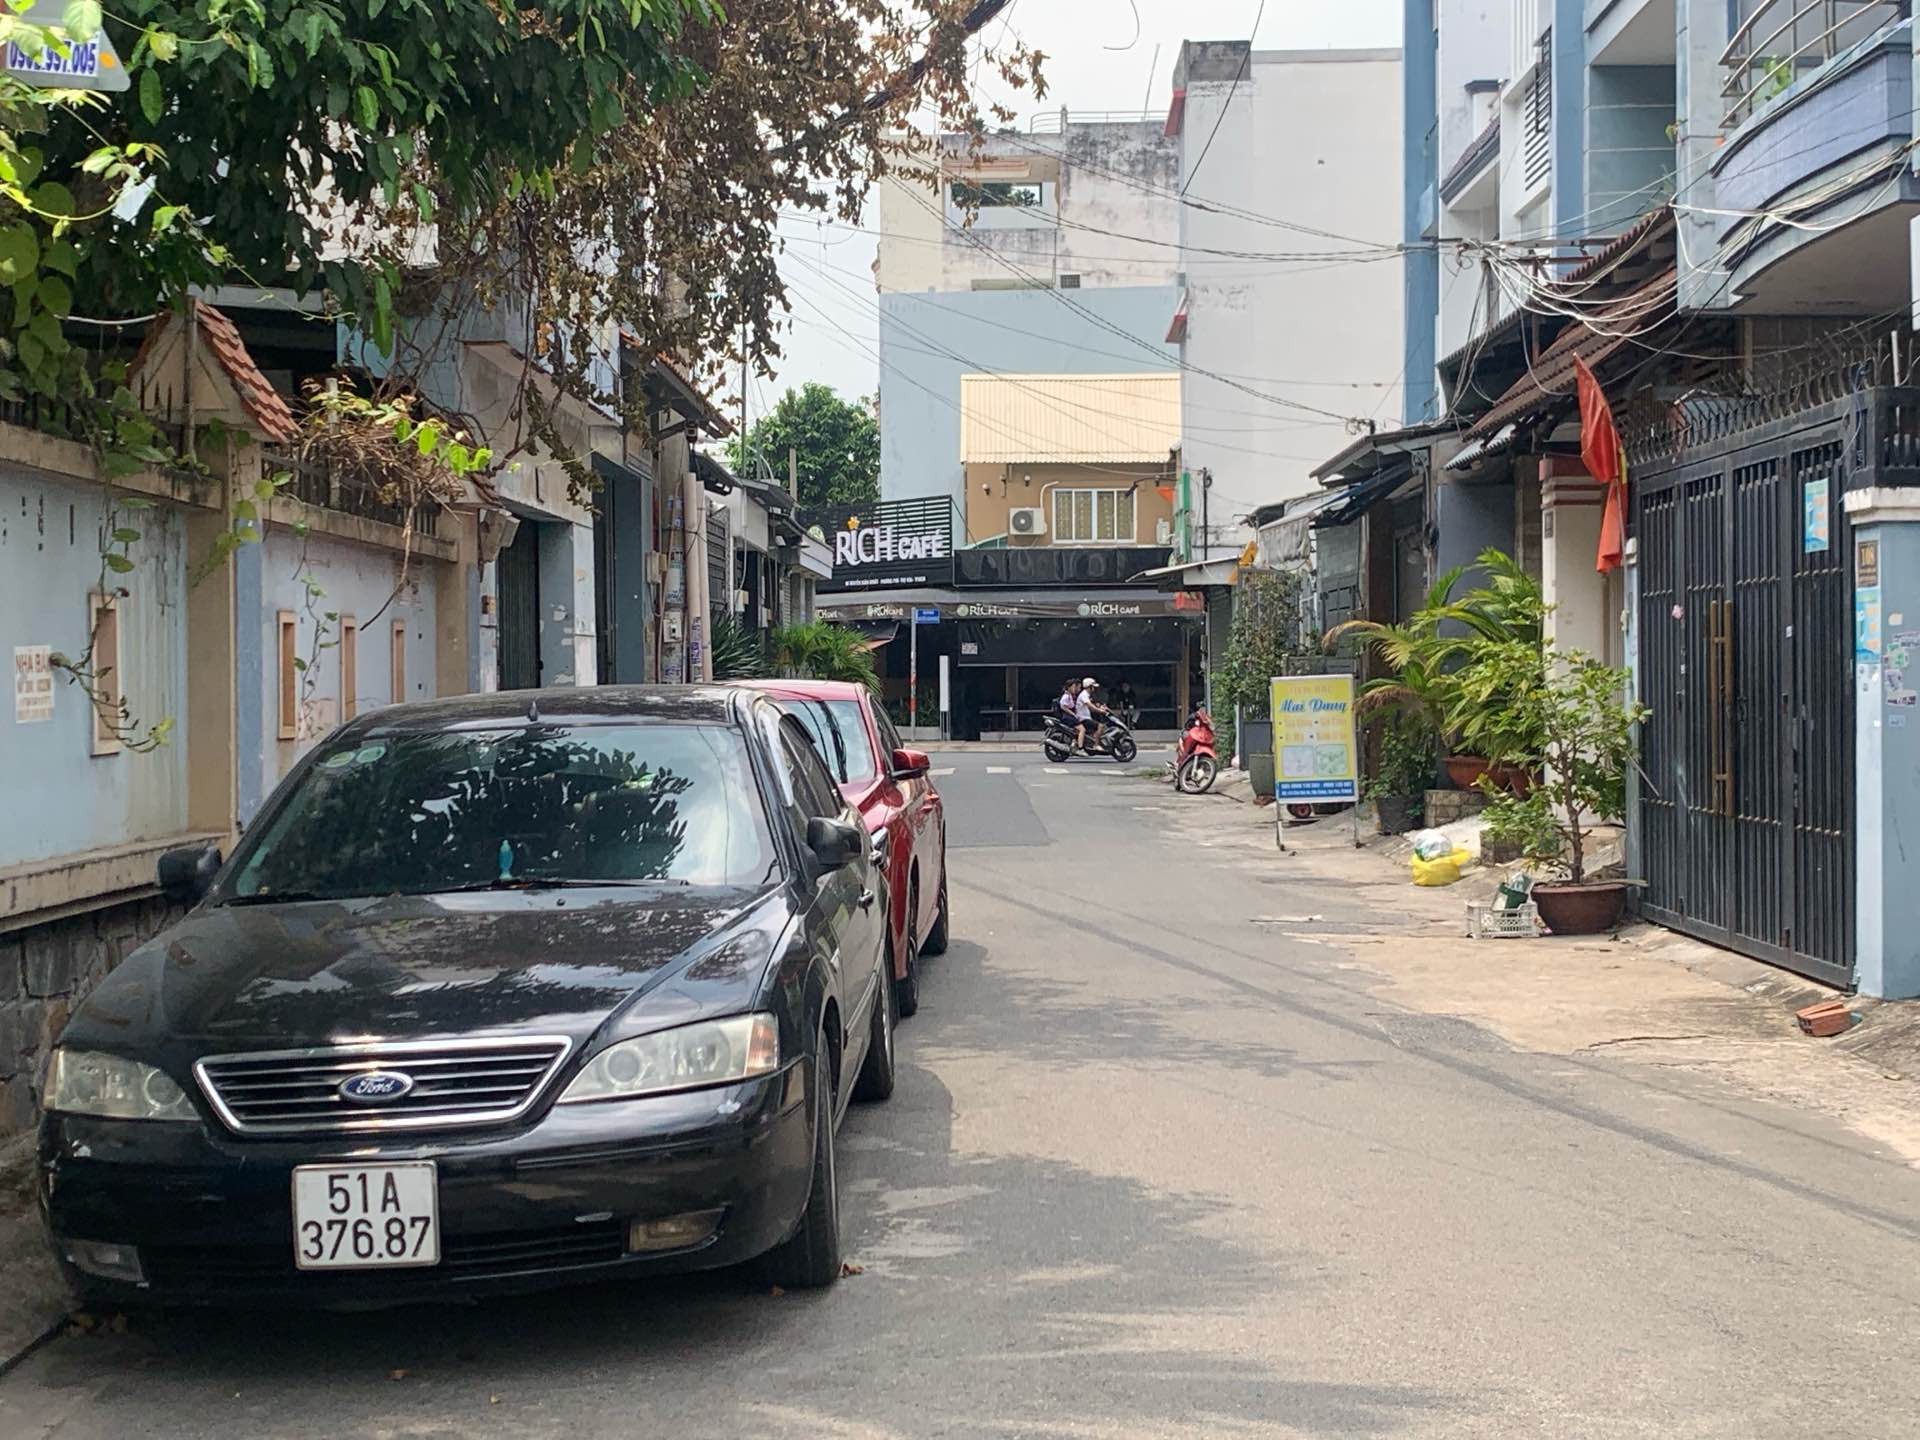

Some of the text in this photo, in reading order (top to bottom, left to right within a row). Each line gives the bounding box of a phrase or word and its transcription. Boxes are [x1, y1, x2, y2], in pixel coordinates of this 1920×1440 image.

[835, 526, 944, 566] RICH CAFÉ
[969, 603, 998, 616] RICH
[1090, 602, 1140, 615] RICH CAFÉ
[356, 1078, 394, 1094] Ford
[328, 1172, 401, 1214] 51A
[302, 1216, 431, 1260] 376.87
